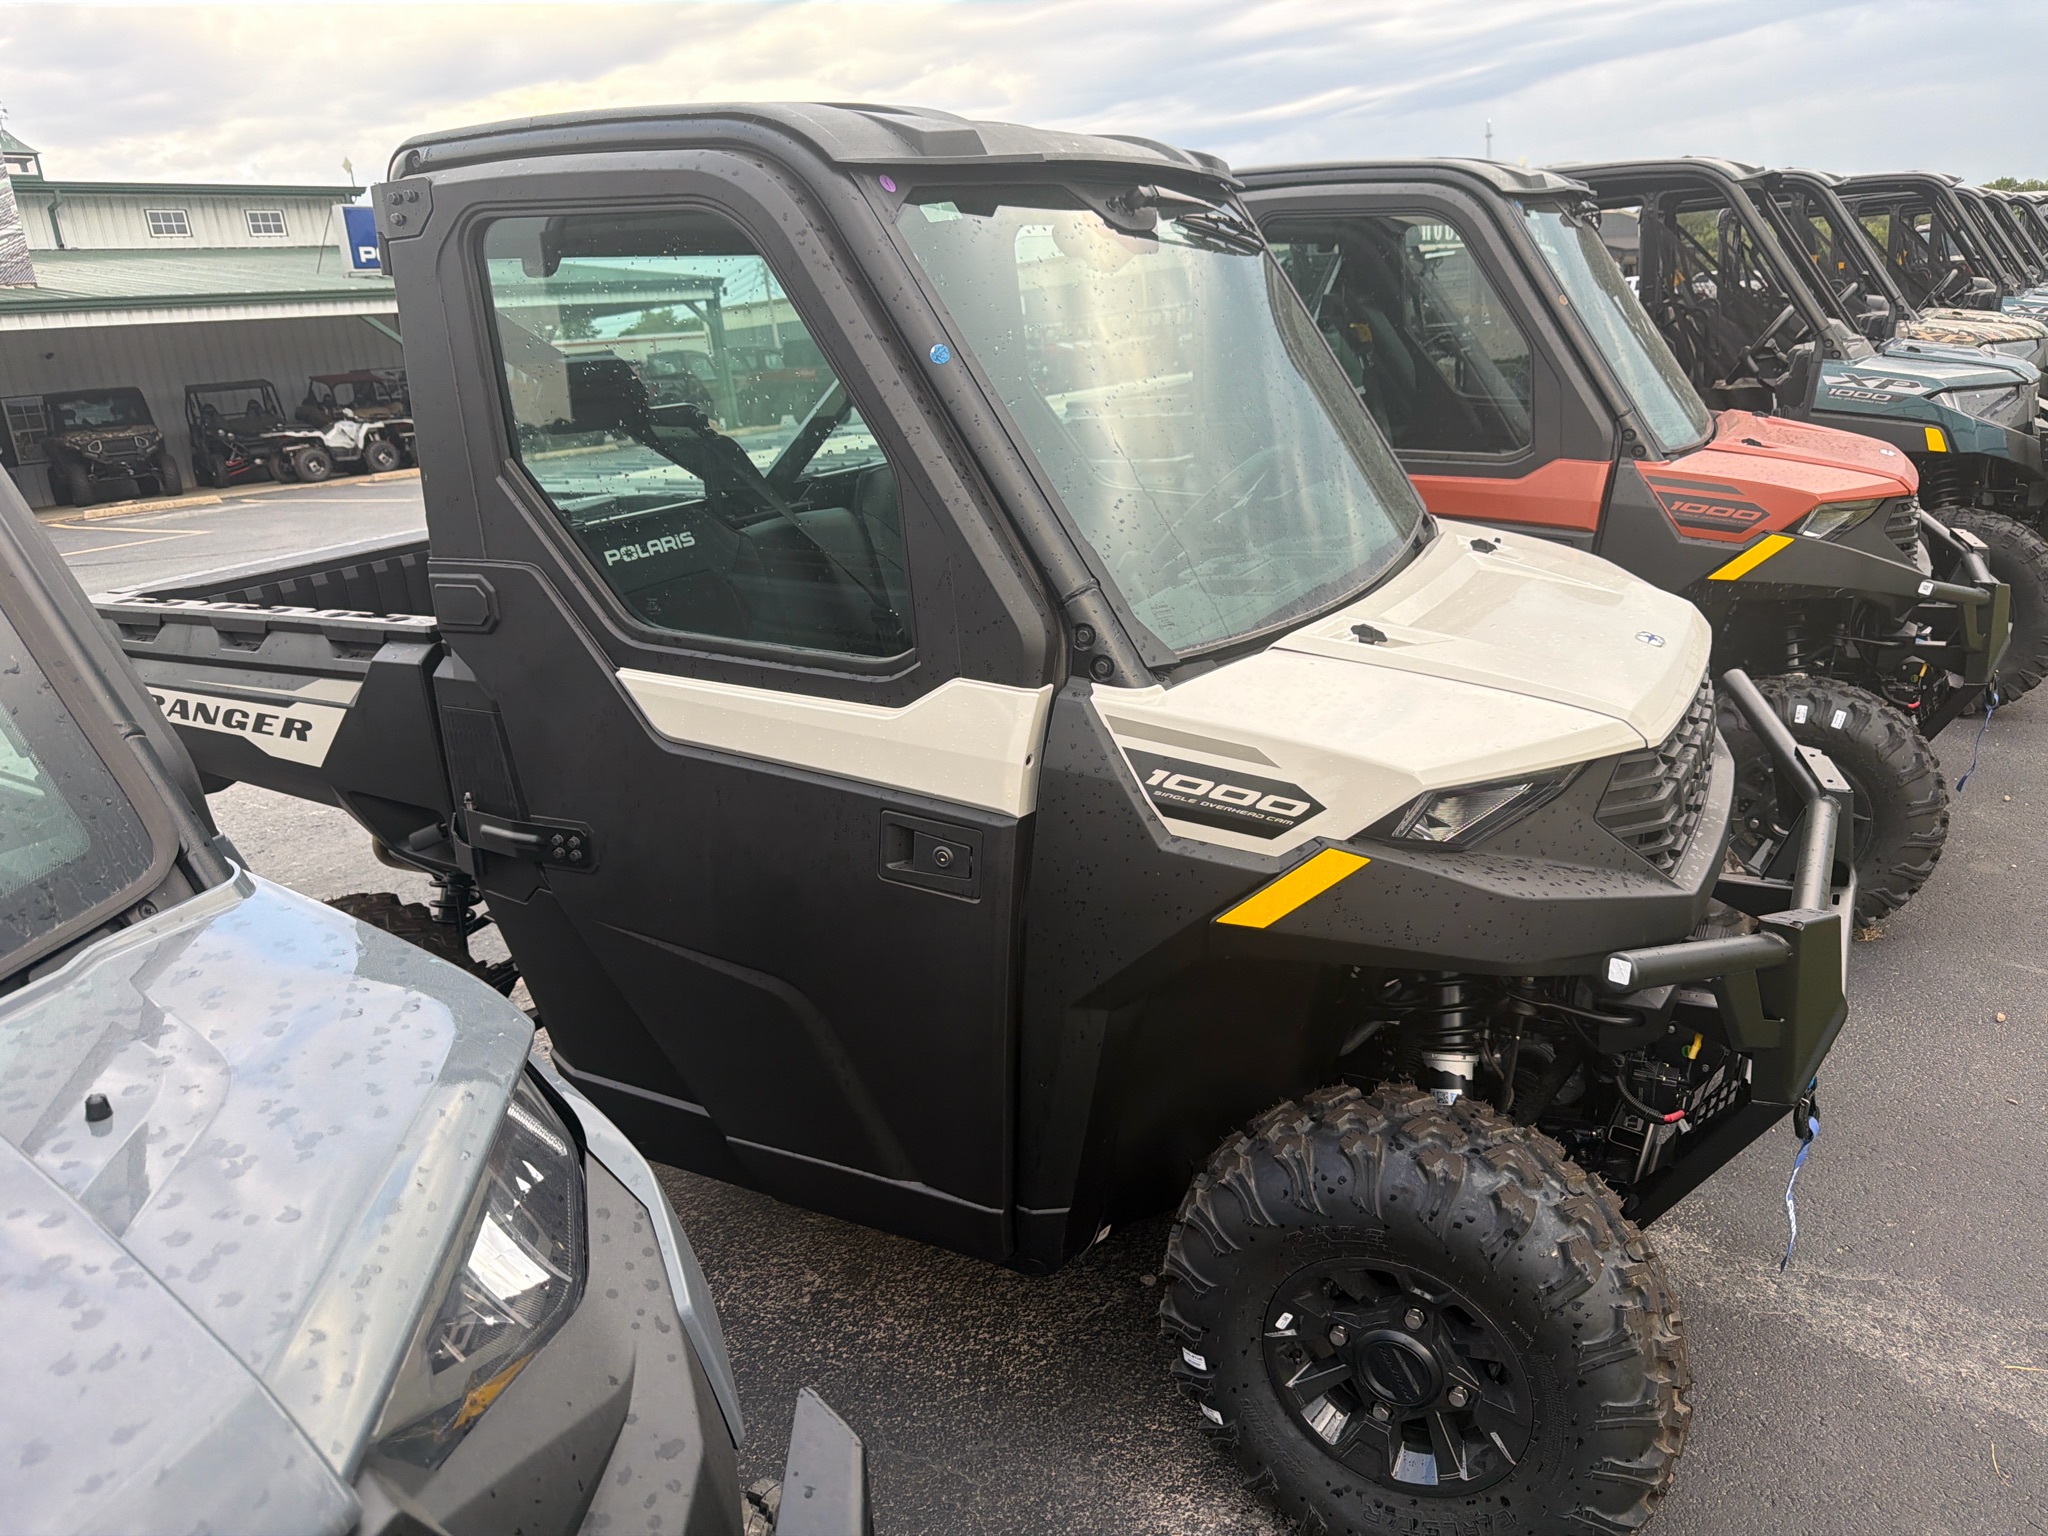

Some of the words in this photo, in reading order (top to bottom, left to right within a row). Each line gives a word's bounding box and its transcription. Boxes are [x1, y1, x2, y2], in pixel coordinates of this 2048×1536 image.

[1828, 373, 1922, 391] XP
[1828, 388, 1892, 401] 1000
[1670, 501, 1762, 521] 1000
[603, 531, 696, 567] POLARIS
[1145, 768, 1311, 817] 1000
[1153, 790, 1198, 804] SINGLE
[1200, 801, 1265, 818] OVERHEAD
[1266, 816, 1295, 826] CAM
